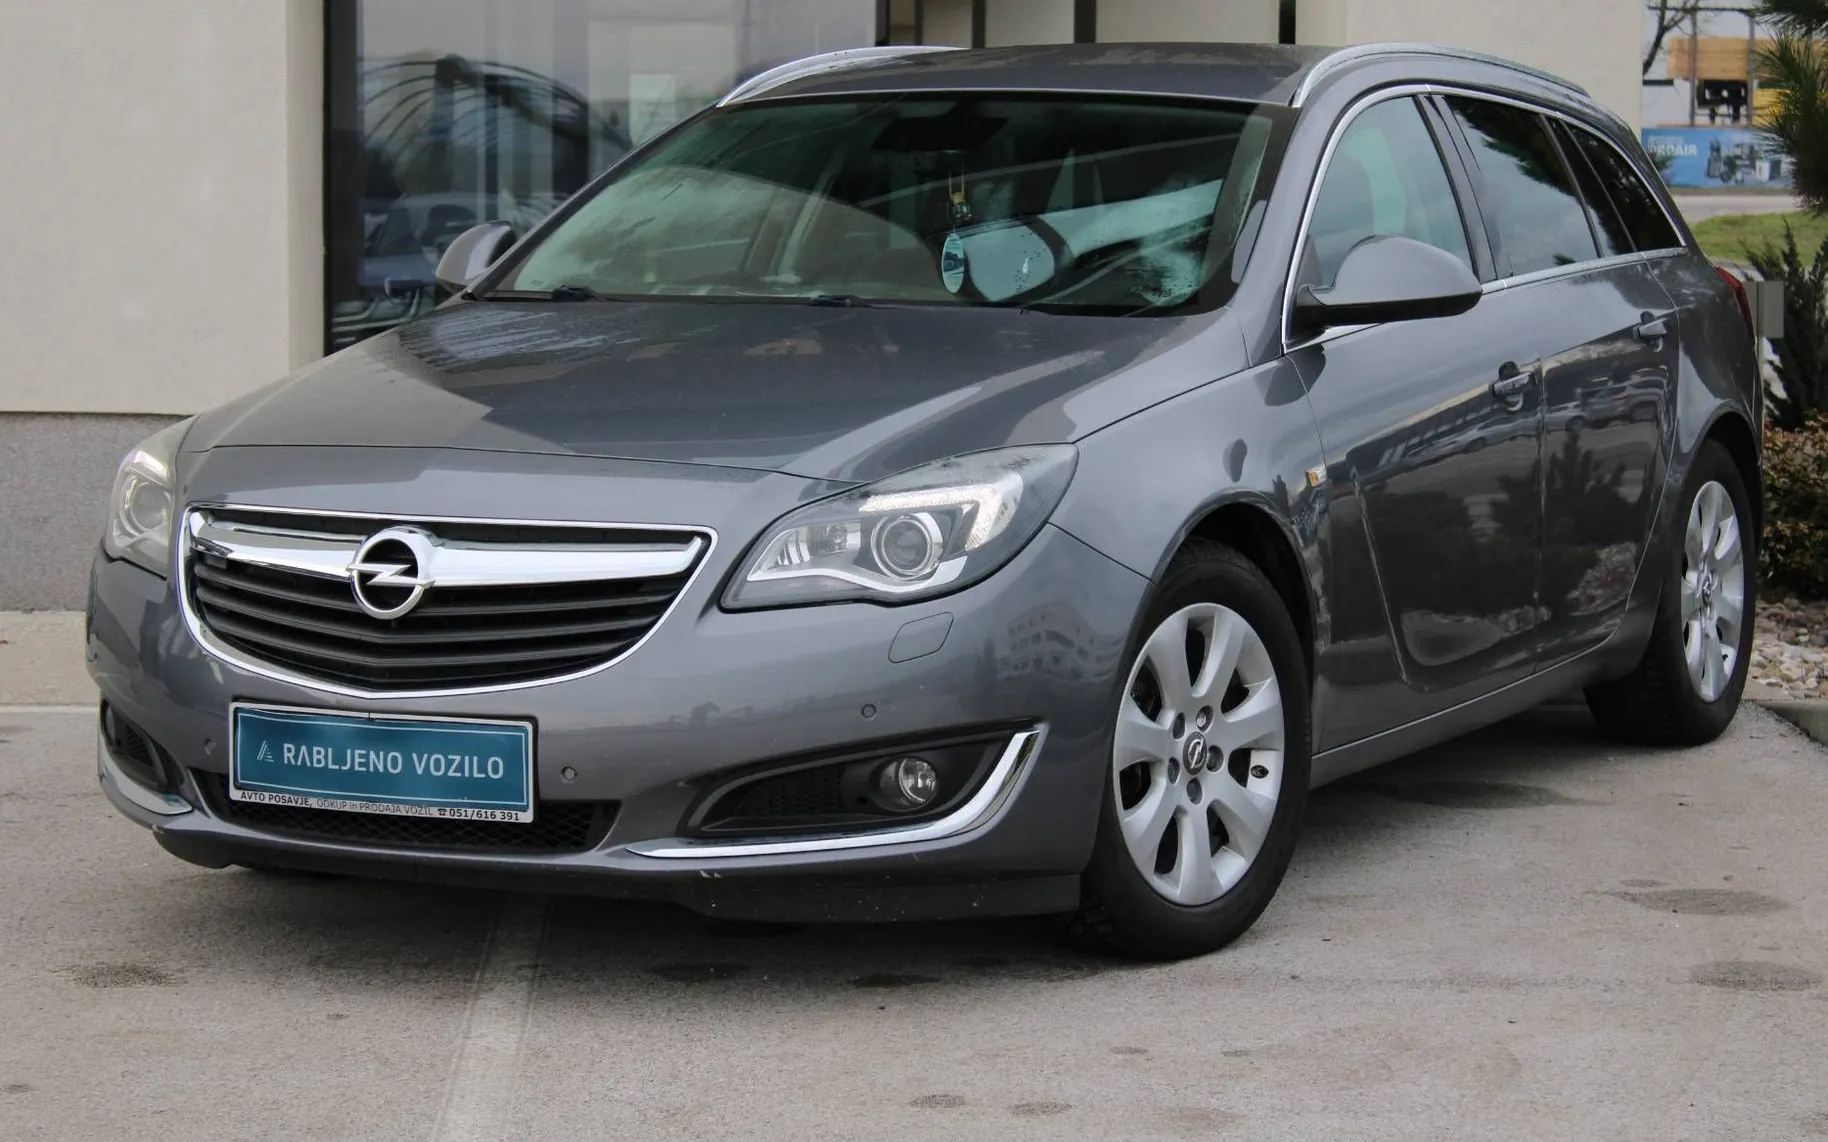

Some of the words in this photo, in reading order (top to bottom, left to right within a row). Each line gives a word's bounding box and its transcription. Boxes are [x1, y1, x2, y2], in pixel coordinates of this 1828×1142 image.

[283, 741, 402, 773] RABLJENO
[412, 753, 504, 779] VOZILO
[240, 791, 266, 802] AVTO
[268, 793, 312, 808] POSAVJE,
[316, 799, 347, 809] ODKUP
[359, 802, 401, 813] PRODAJA
[404, 806, 434, 816] VOZIL
[449, 808, 496, 819] 051/616
[500, 811, 520, 821] 391
